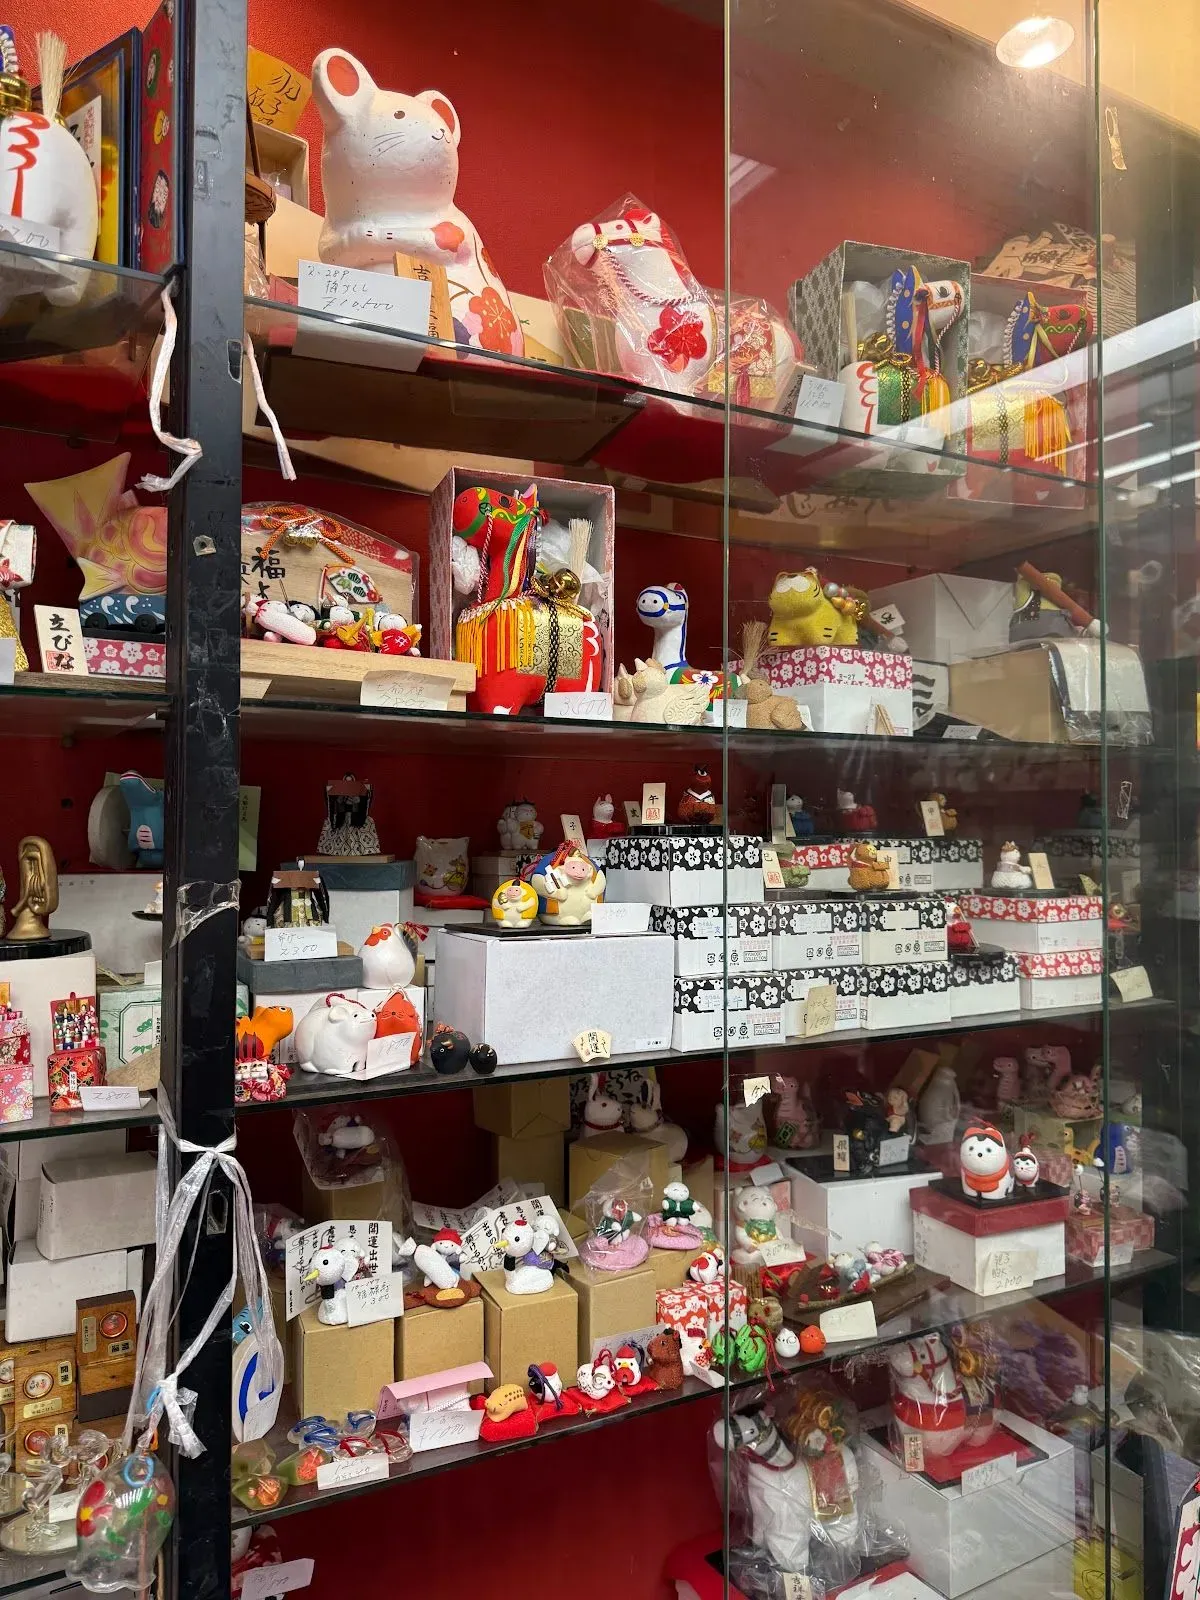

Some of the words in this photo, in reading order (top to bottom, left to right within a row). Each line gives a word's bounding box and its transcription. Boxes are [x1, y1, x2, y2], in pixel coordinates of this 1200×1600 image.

[48, 613, 75, 669] 立びな
[648, 794, 659, 805] 午
